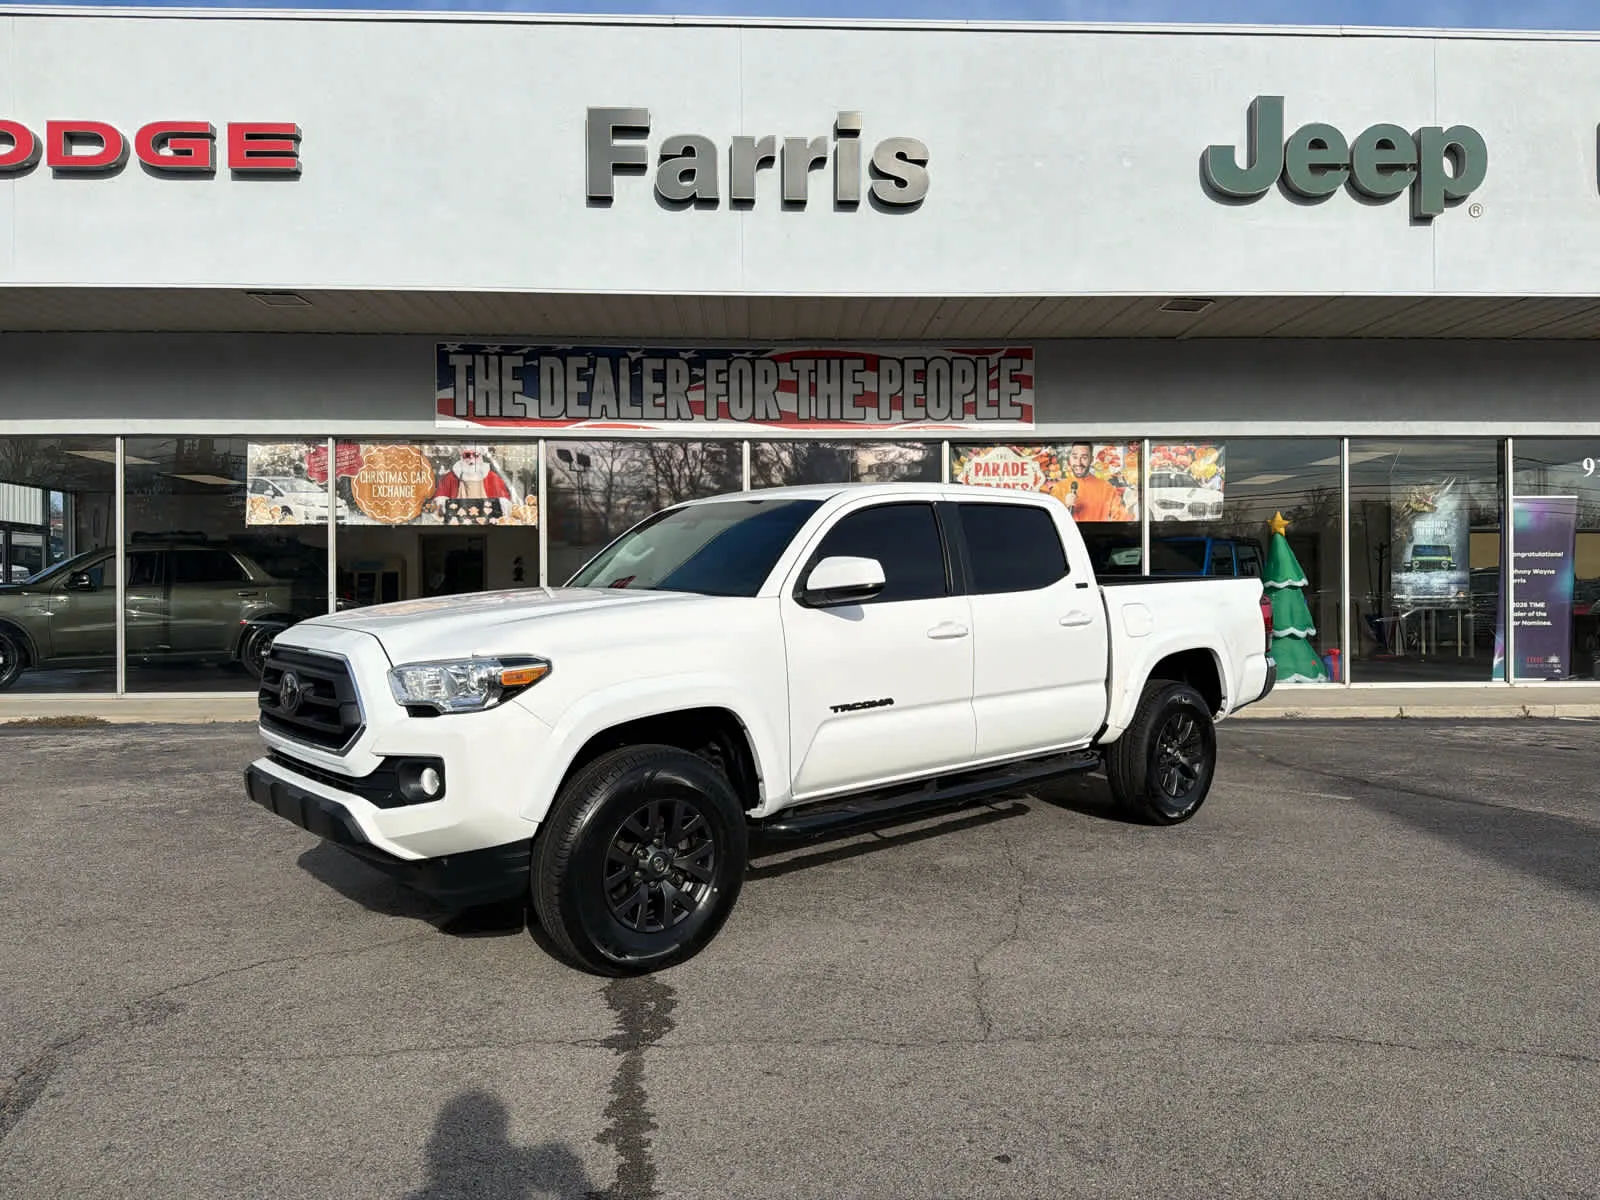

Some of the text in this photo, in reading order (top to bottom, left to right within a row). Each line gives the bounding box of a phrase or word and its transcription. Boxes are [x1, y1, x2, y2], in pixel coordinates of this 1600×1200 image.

[585, 106, 931, 210] Farris
[1199, 95, 1488, 224] Jeep
[450, 354, 1024, 420] THE DEALER FOR THE PEOPLE
[974, 462, 1029, 476] PARADE
[1582, 457, 1600, 478] 9
[359, 470, 427, 485] CHRISTMAS CAR
[372, 485, 416, 498] EXCHANGE
[1533, 568, 1556, 576] Wayne
[829, 697, 895, 713] TACOMA
